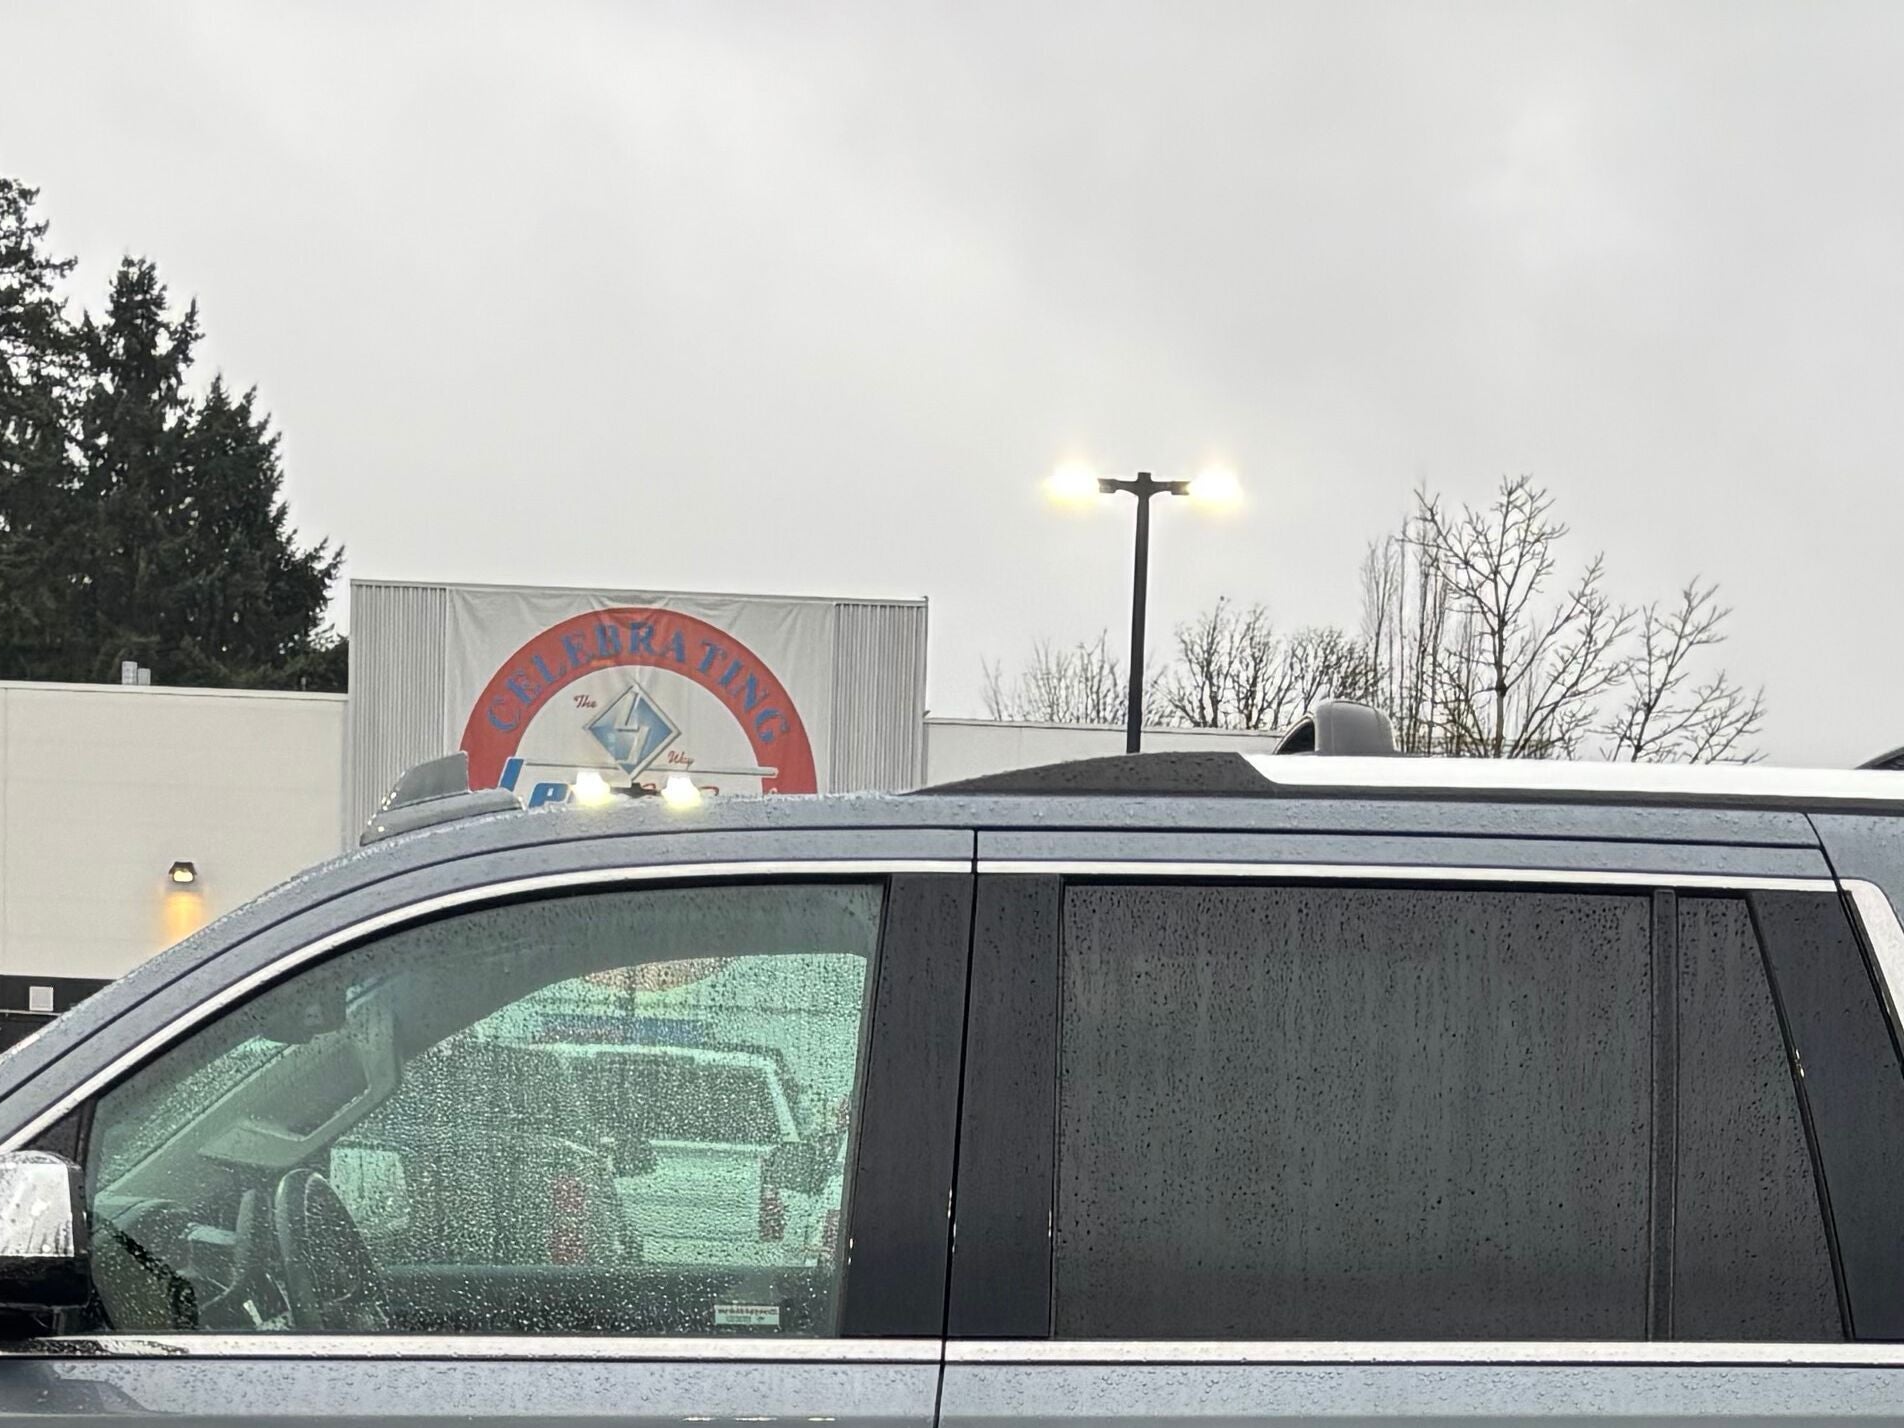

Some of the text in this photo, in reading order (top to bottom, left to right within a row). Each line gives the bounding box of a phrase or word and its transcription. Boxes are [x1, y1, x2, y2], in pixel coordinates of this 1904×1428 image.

[486, 622, 790, 743] CELEBRATING
[574, 694, 597, 709] The
[667, 750, 695, 769] Way
